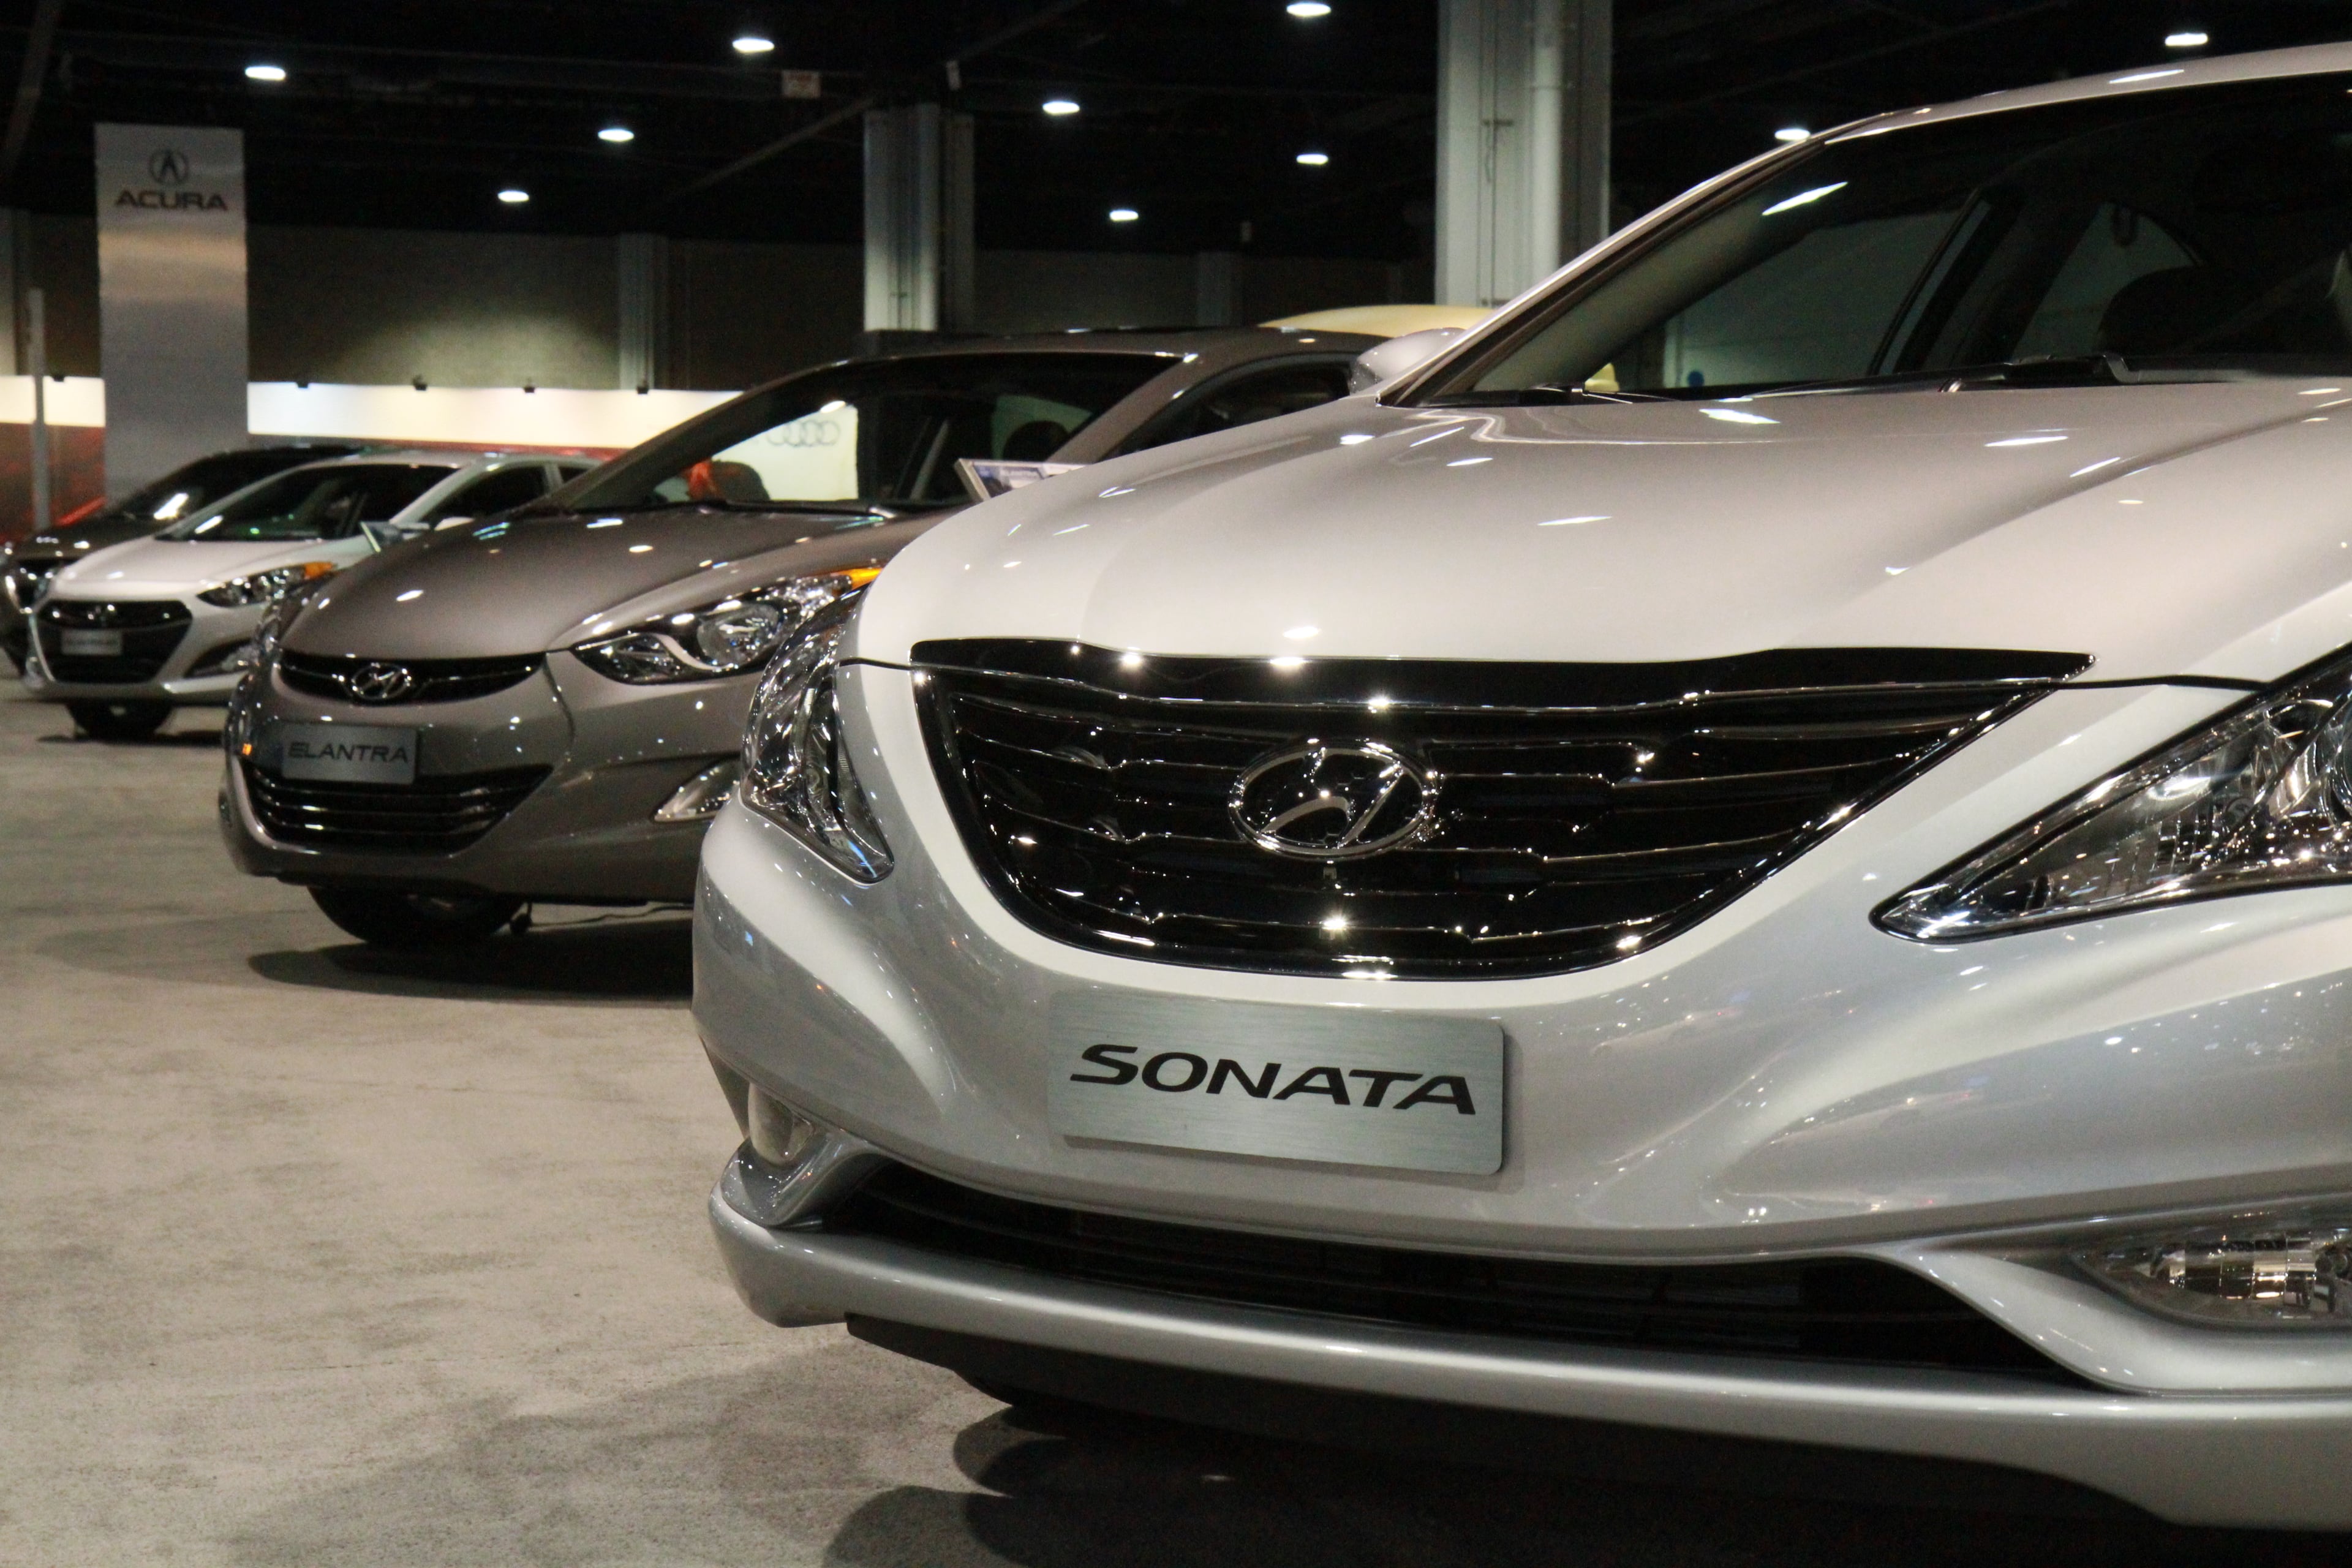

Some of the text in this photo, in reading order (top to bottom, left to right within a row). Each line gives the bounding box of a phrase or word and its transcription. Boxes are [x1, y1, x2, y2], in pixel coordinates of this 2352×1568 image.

[115, 190, 227, 211] ACURA
[288, 741, 409, 763] ELANTRA
[1070, 1044, 1477, 1115] SONATA
